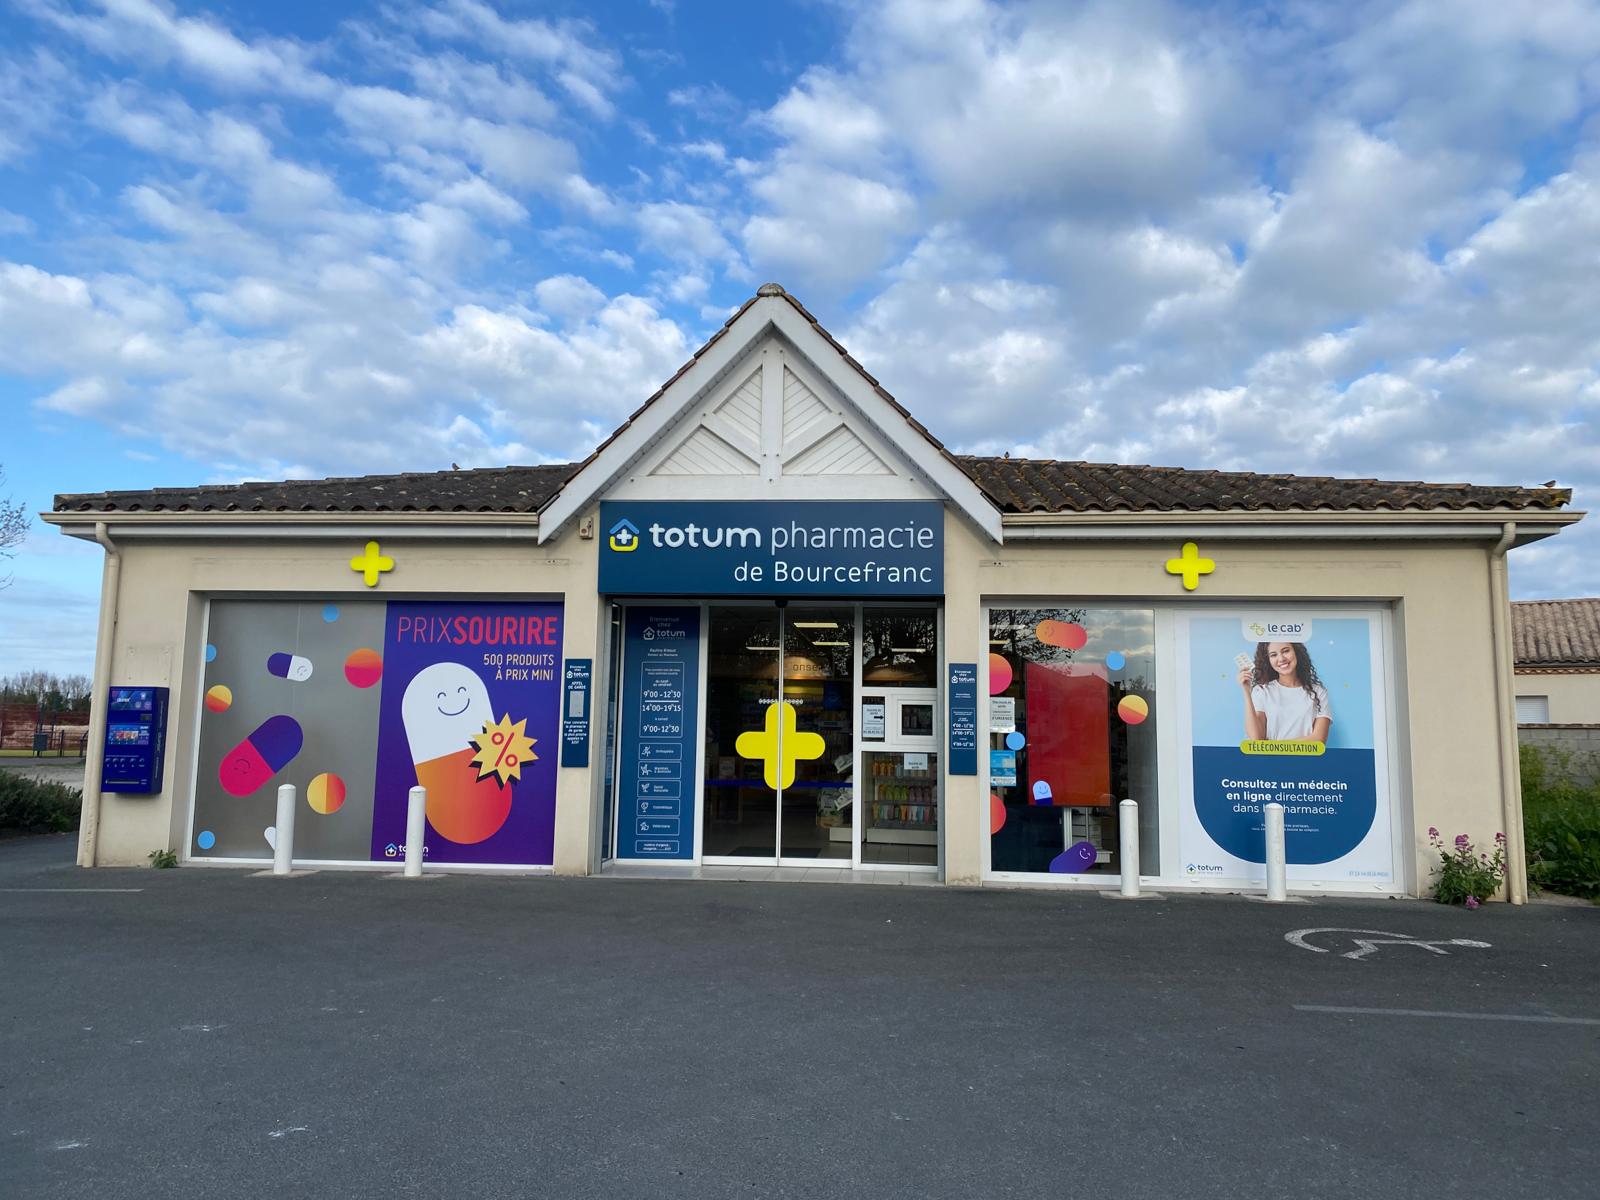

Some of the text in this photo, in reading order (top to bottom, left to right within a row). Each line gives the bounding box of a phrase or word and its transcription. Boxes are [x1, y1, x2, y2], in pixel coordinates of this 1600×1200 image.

[649, 520, 934, 555] totum pharmacie
[734, 561, 932, 583] de Bourcefranc
[1267, 623, 1278, 633] le
[483, 654, 554, 666] 500 PRODUITS
[505, 669, 529, 681] PRIX
[531, 669, 554, 681] MINI
[1248, 742, 1318, 753] TÉLÉCONSULTATION
[1221, 778, 1347, 790] Consultez un médecin
[1226, 791, 1343, 803] en ligne directement
[1233, 803, 1260, 813] dans
[1283, 804, 1337, 814] harmacie.
